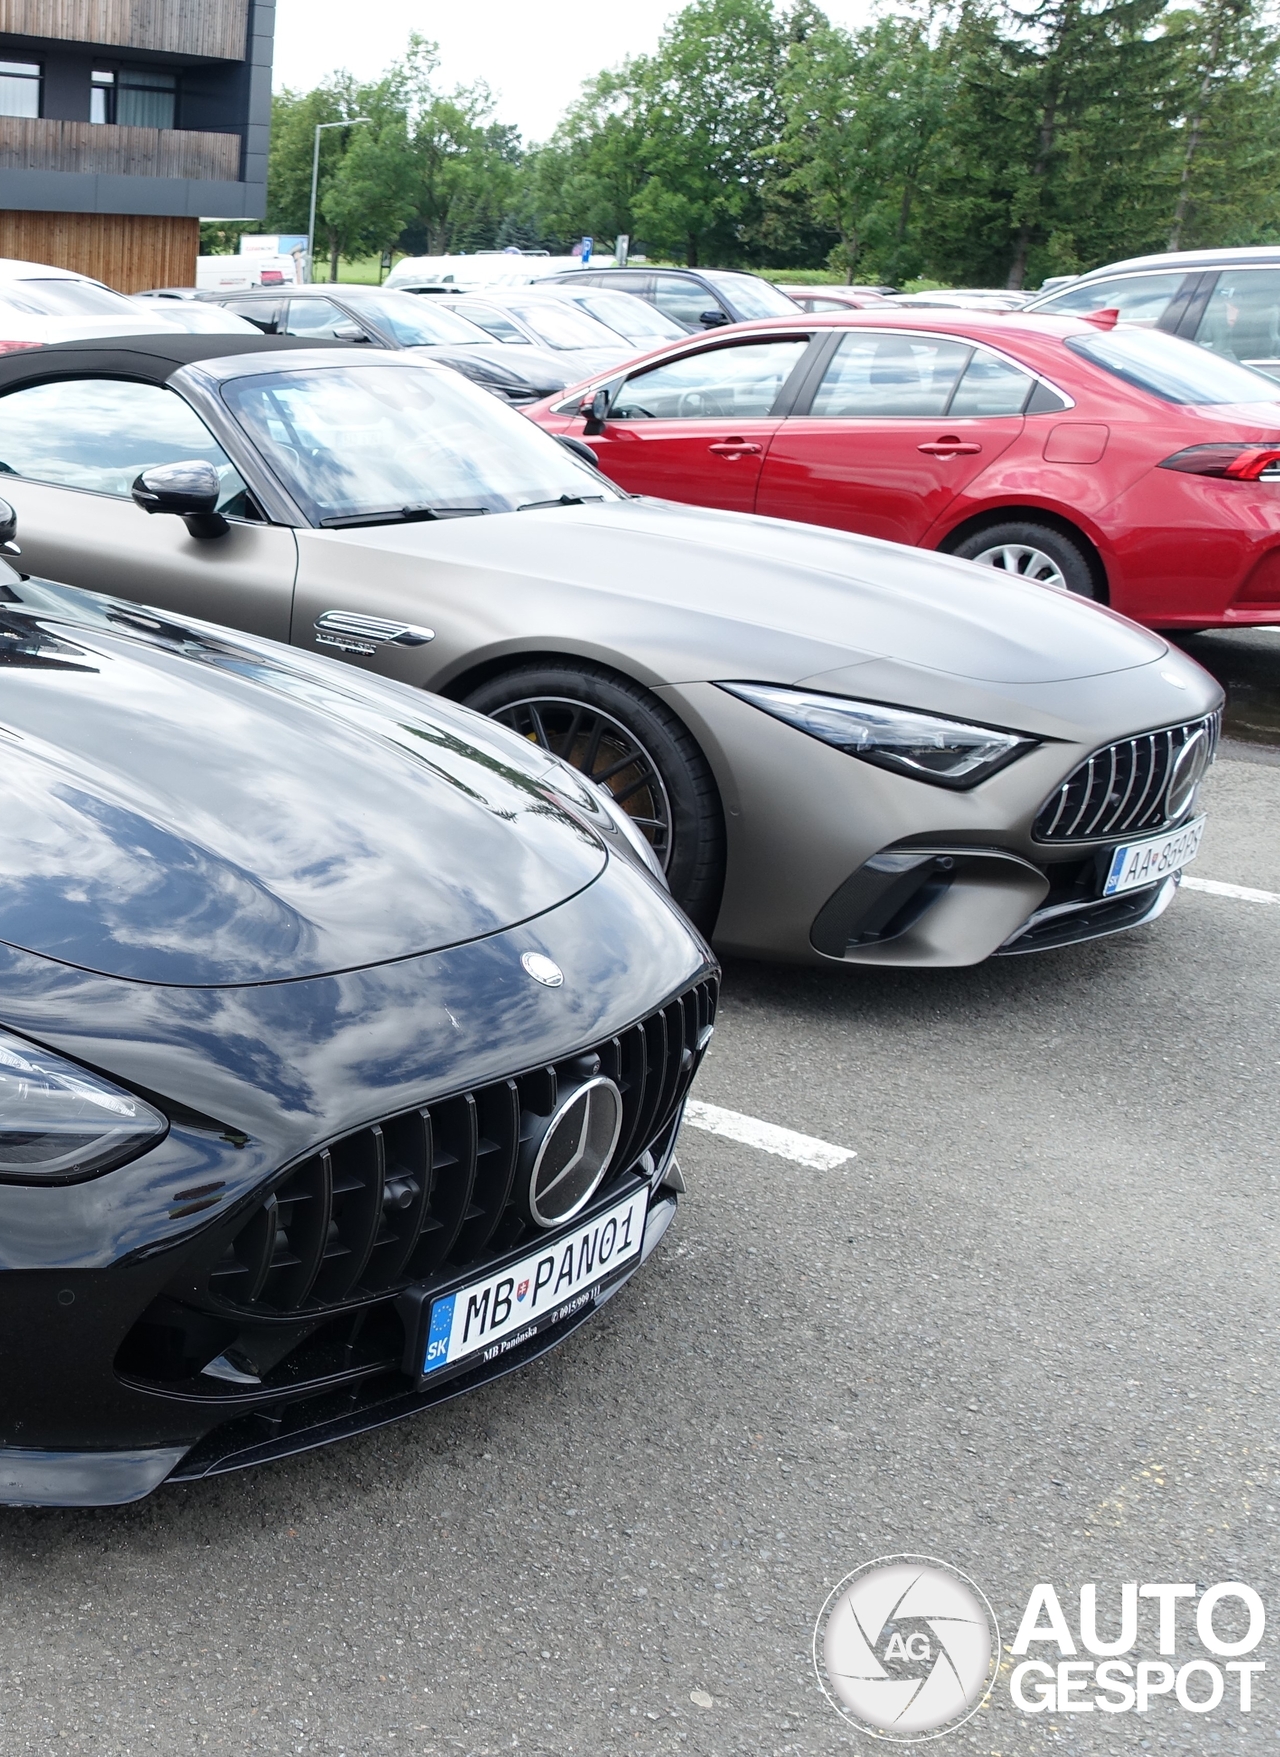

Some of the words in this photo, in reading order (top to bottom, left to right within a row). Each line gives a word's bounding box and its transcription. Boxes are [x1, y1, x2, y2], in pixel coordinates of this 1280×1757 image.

[1124, 848, 1153, 883] AA
[462, 1277, 515, 1344] MB
[530, 1204, 634, 1308] PAN01
[427, 1337, 448, 1361] SK
[483, 1345, 499, 1362] MB
[500, 1326, 538, 1353] Panónska
